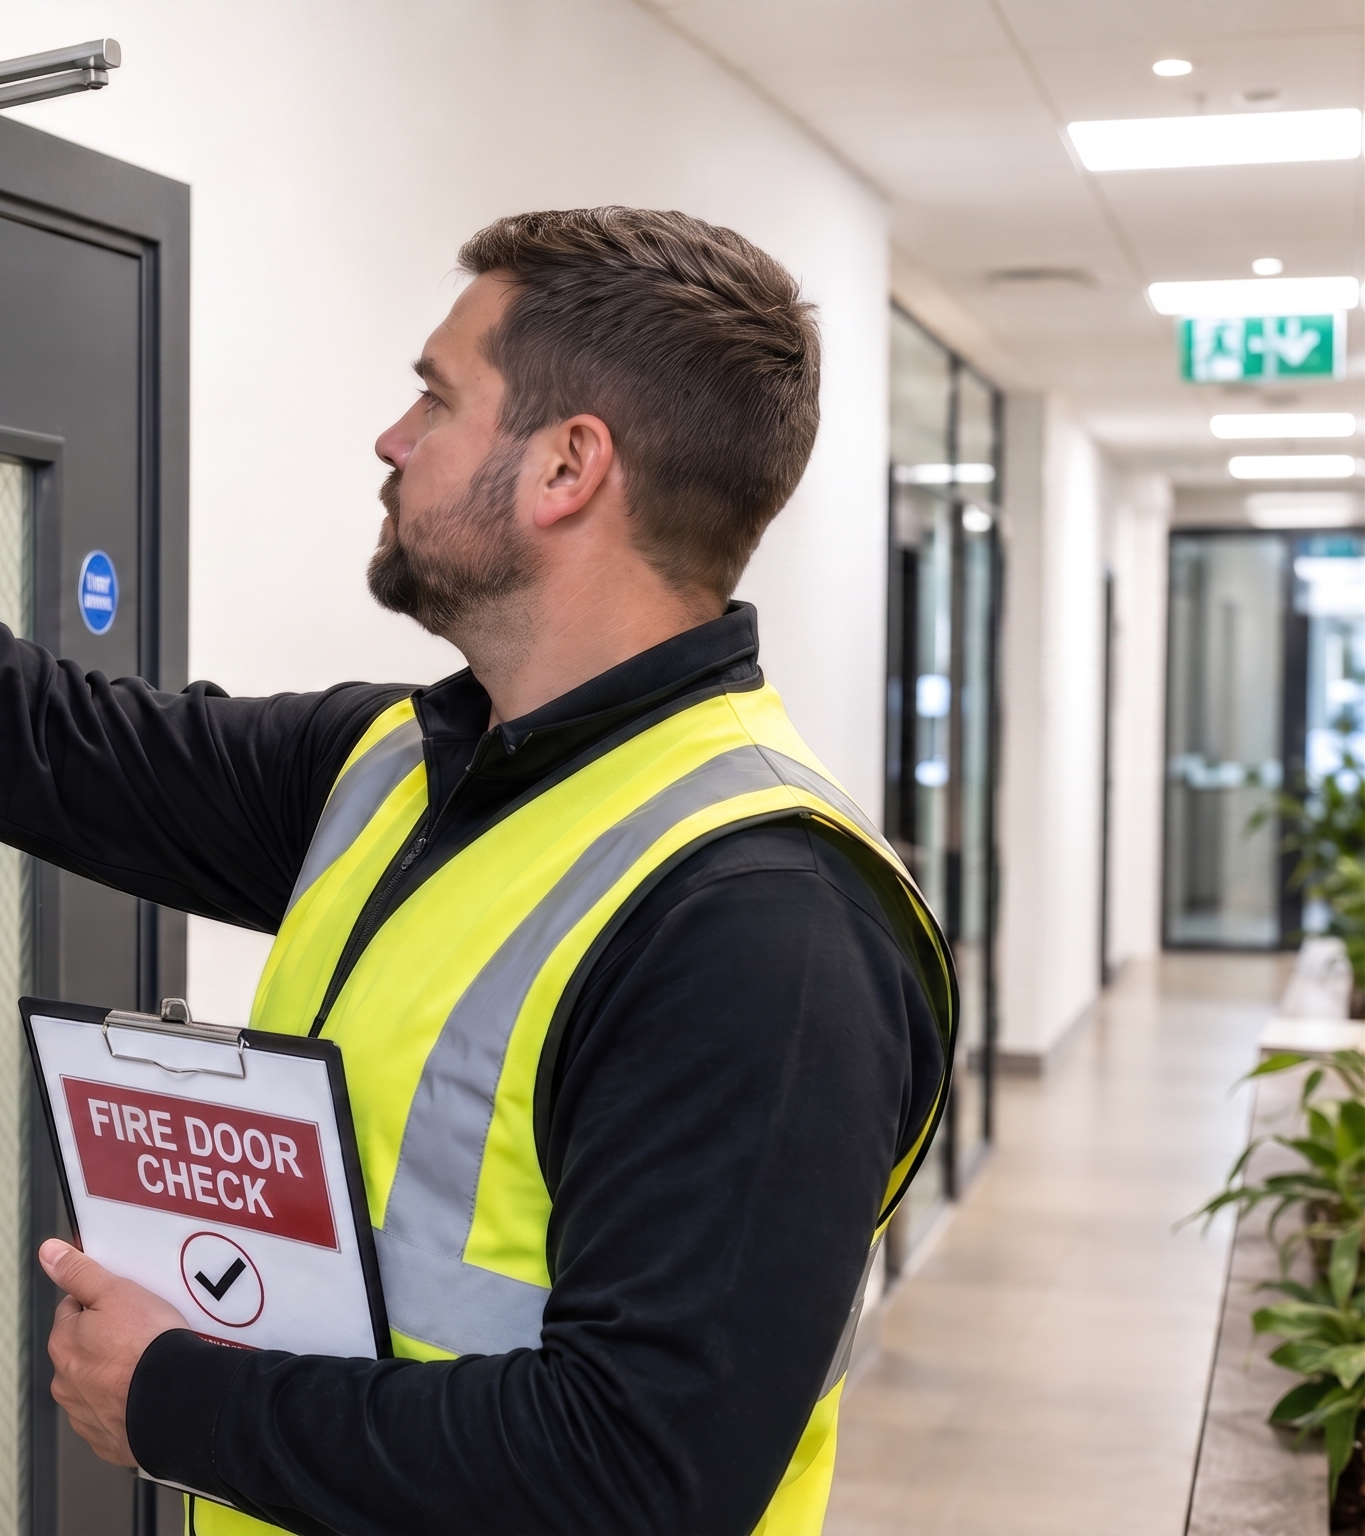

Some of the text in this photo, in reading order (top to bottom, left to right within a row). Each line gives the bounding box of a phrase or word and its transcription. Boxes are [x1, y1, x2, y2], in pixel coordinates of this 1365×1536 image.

[88, 1098, 303, 1178] FIRE DOOR
[138, 1154, 273, 1217] CHECK
